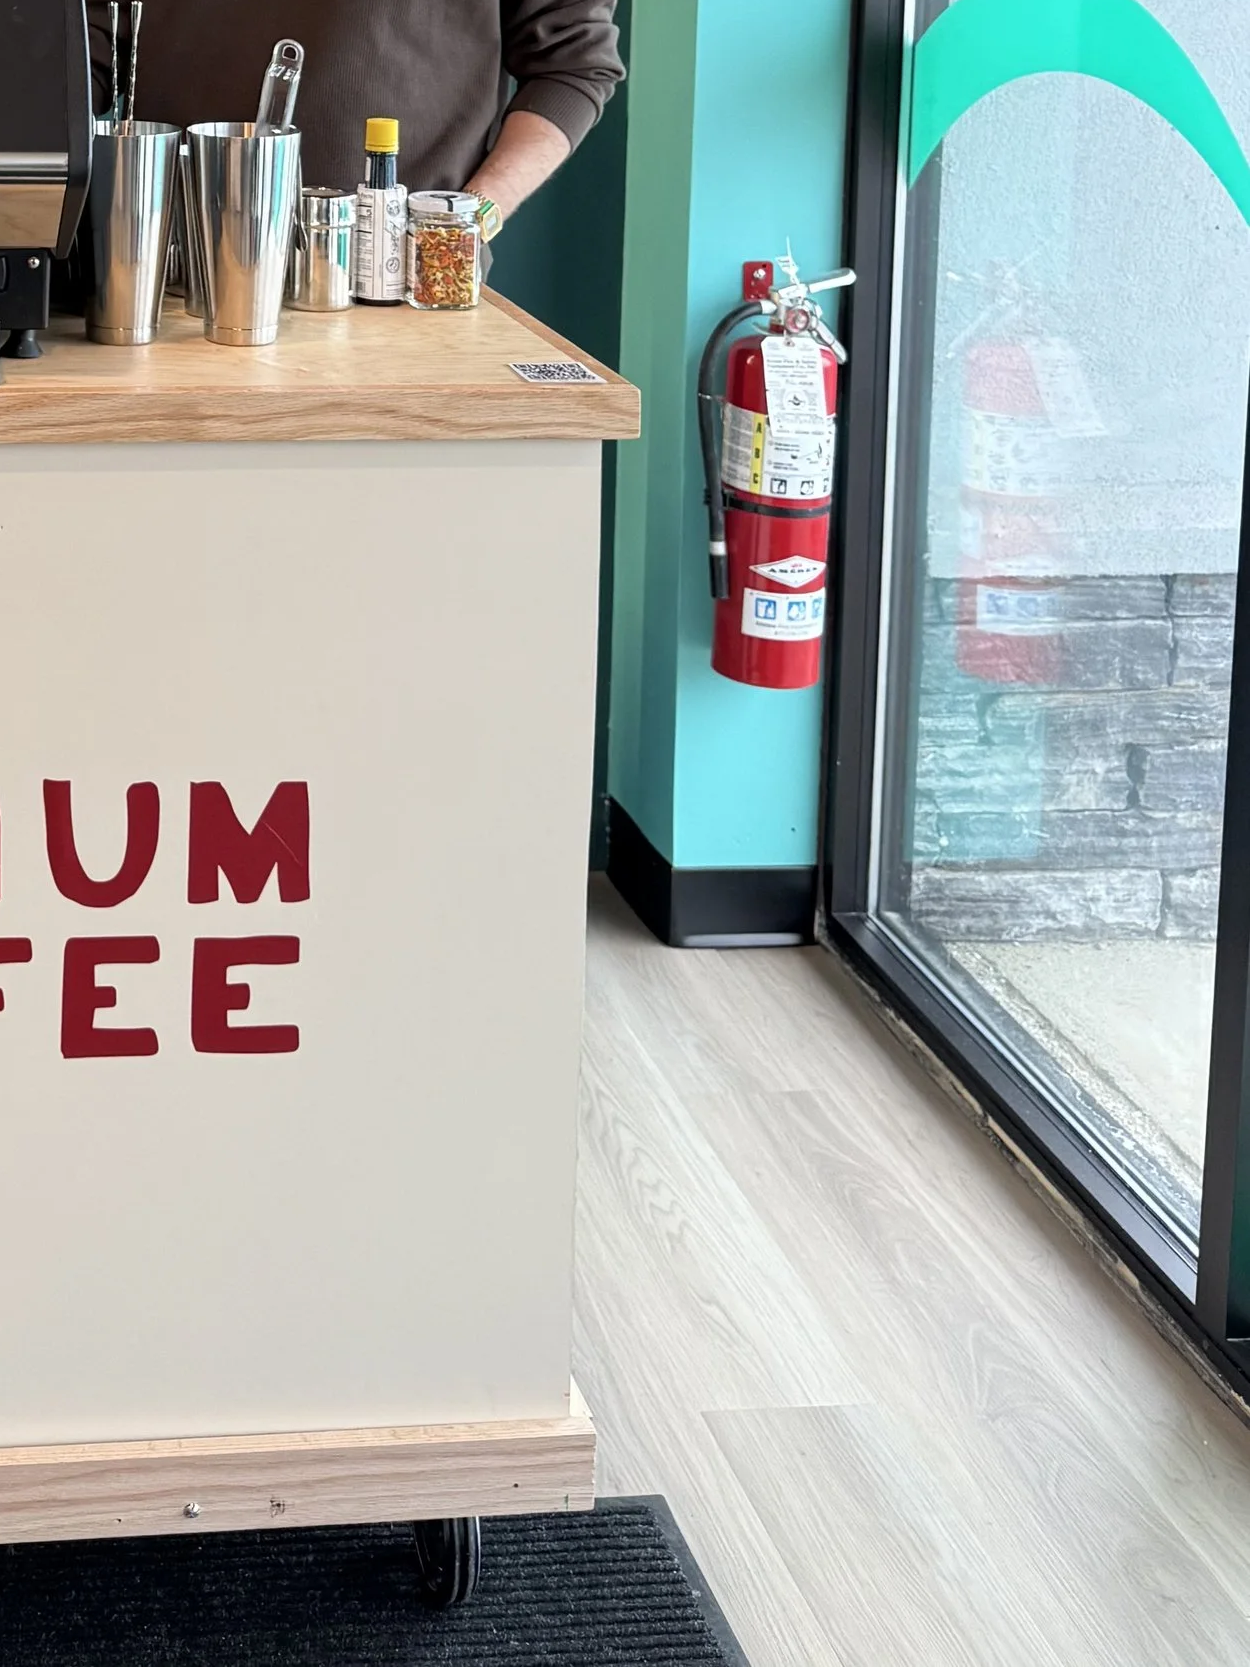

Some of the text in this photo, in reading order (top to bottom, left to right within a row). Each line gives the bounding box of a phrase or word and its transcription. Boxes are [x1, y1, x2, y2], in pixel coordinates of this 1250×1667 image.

[755, 422, 762, 433] A
[754, 447, 760, 459] B
[753, 473, 759, 484] C
